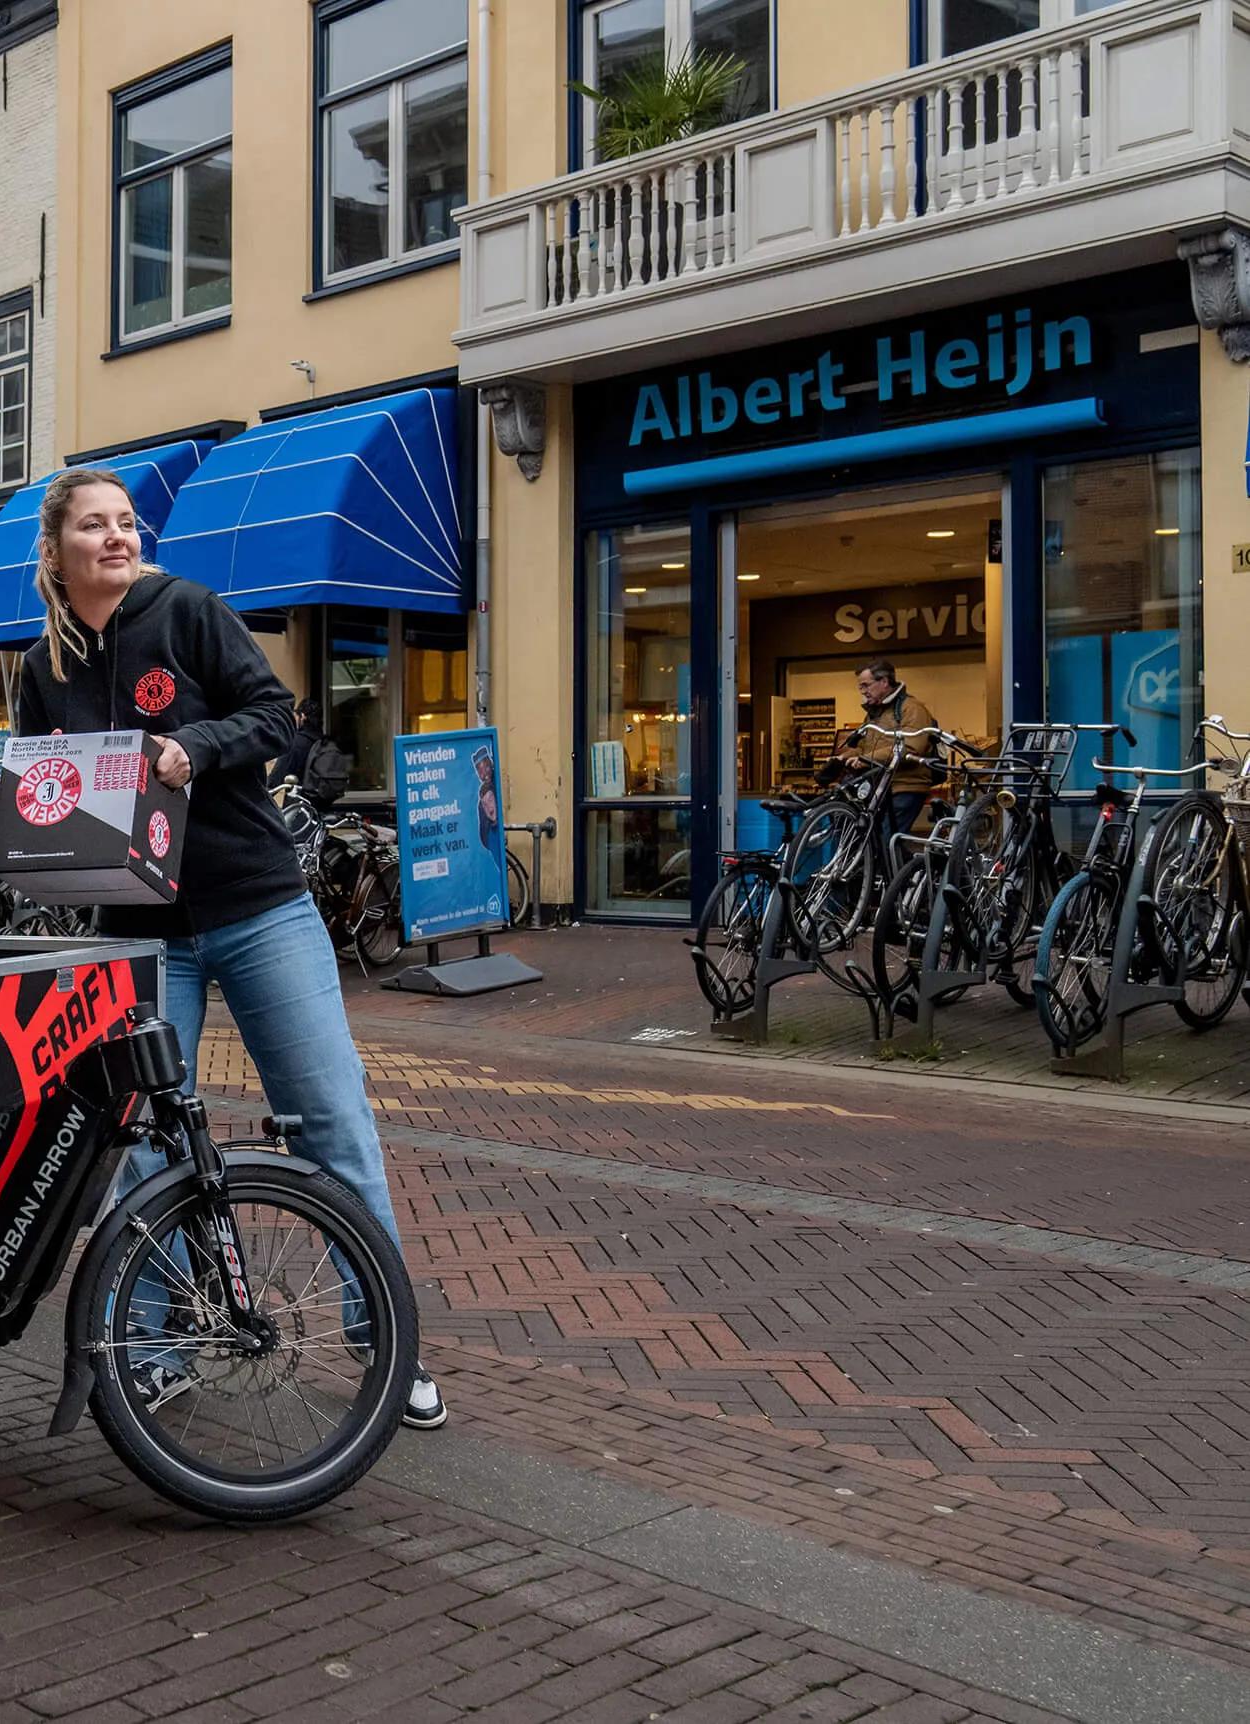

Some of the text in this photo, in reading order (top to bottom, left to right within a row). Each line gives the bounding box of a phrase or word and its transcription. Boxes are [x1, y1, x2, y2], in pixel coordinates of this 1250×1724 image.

[629, 308, 1092, 447] Albert Heijn
[136, 673, 164, 695] JOPEN
[103, 754, 113, 791] ANYTHING
[112, 753, 122, 790] ANYTHING
[120, 752, 131, 790] ANYTHING
[128, 752, 140, 790] ANYTHING
[404, 746, 456, 766] Vrienden
[19, 760, 75, 793] JOPEN
[94, 755, 104, 792] ANYTHING
[406, 768, 446, 784] maken
[22, 791, 79, 823] JOPEN
[407, 784, 440, 803] in elk
[408, 800, 462, 825] gangpad.
[410, 821, 460, 840] Maak er
[412, 838, 469, 858] werk van.
[32, 962, 117, 1076] CRAFT
[32, 1103, 86, 1202] ARROW
